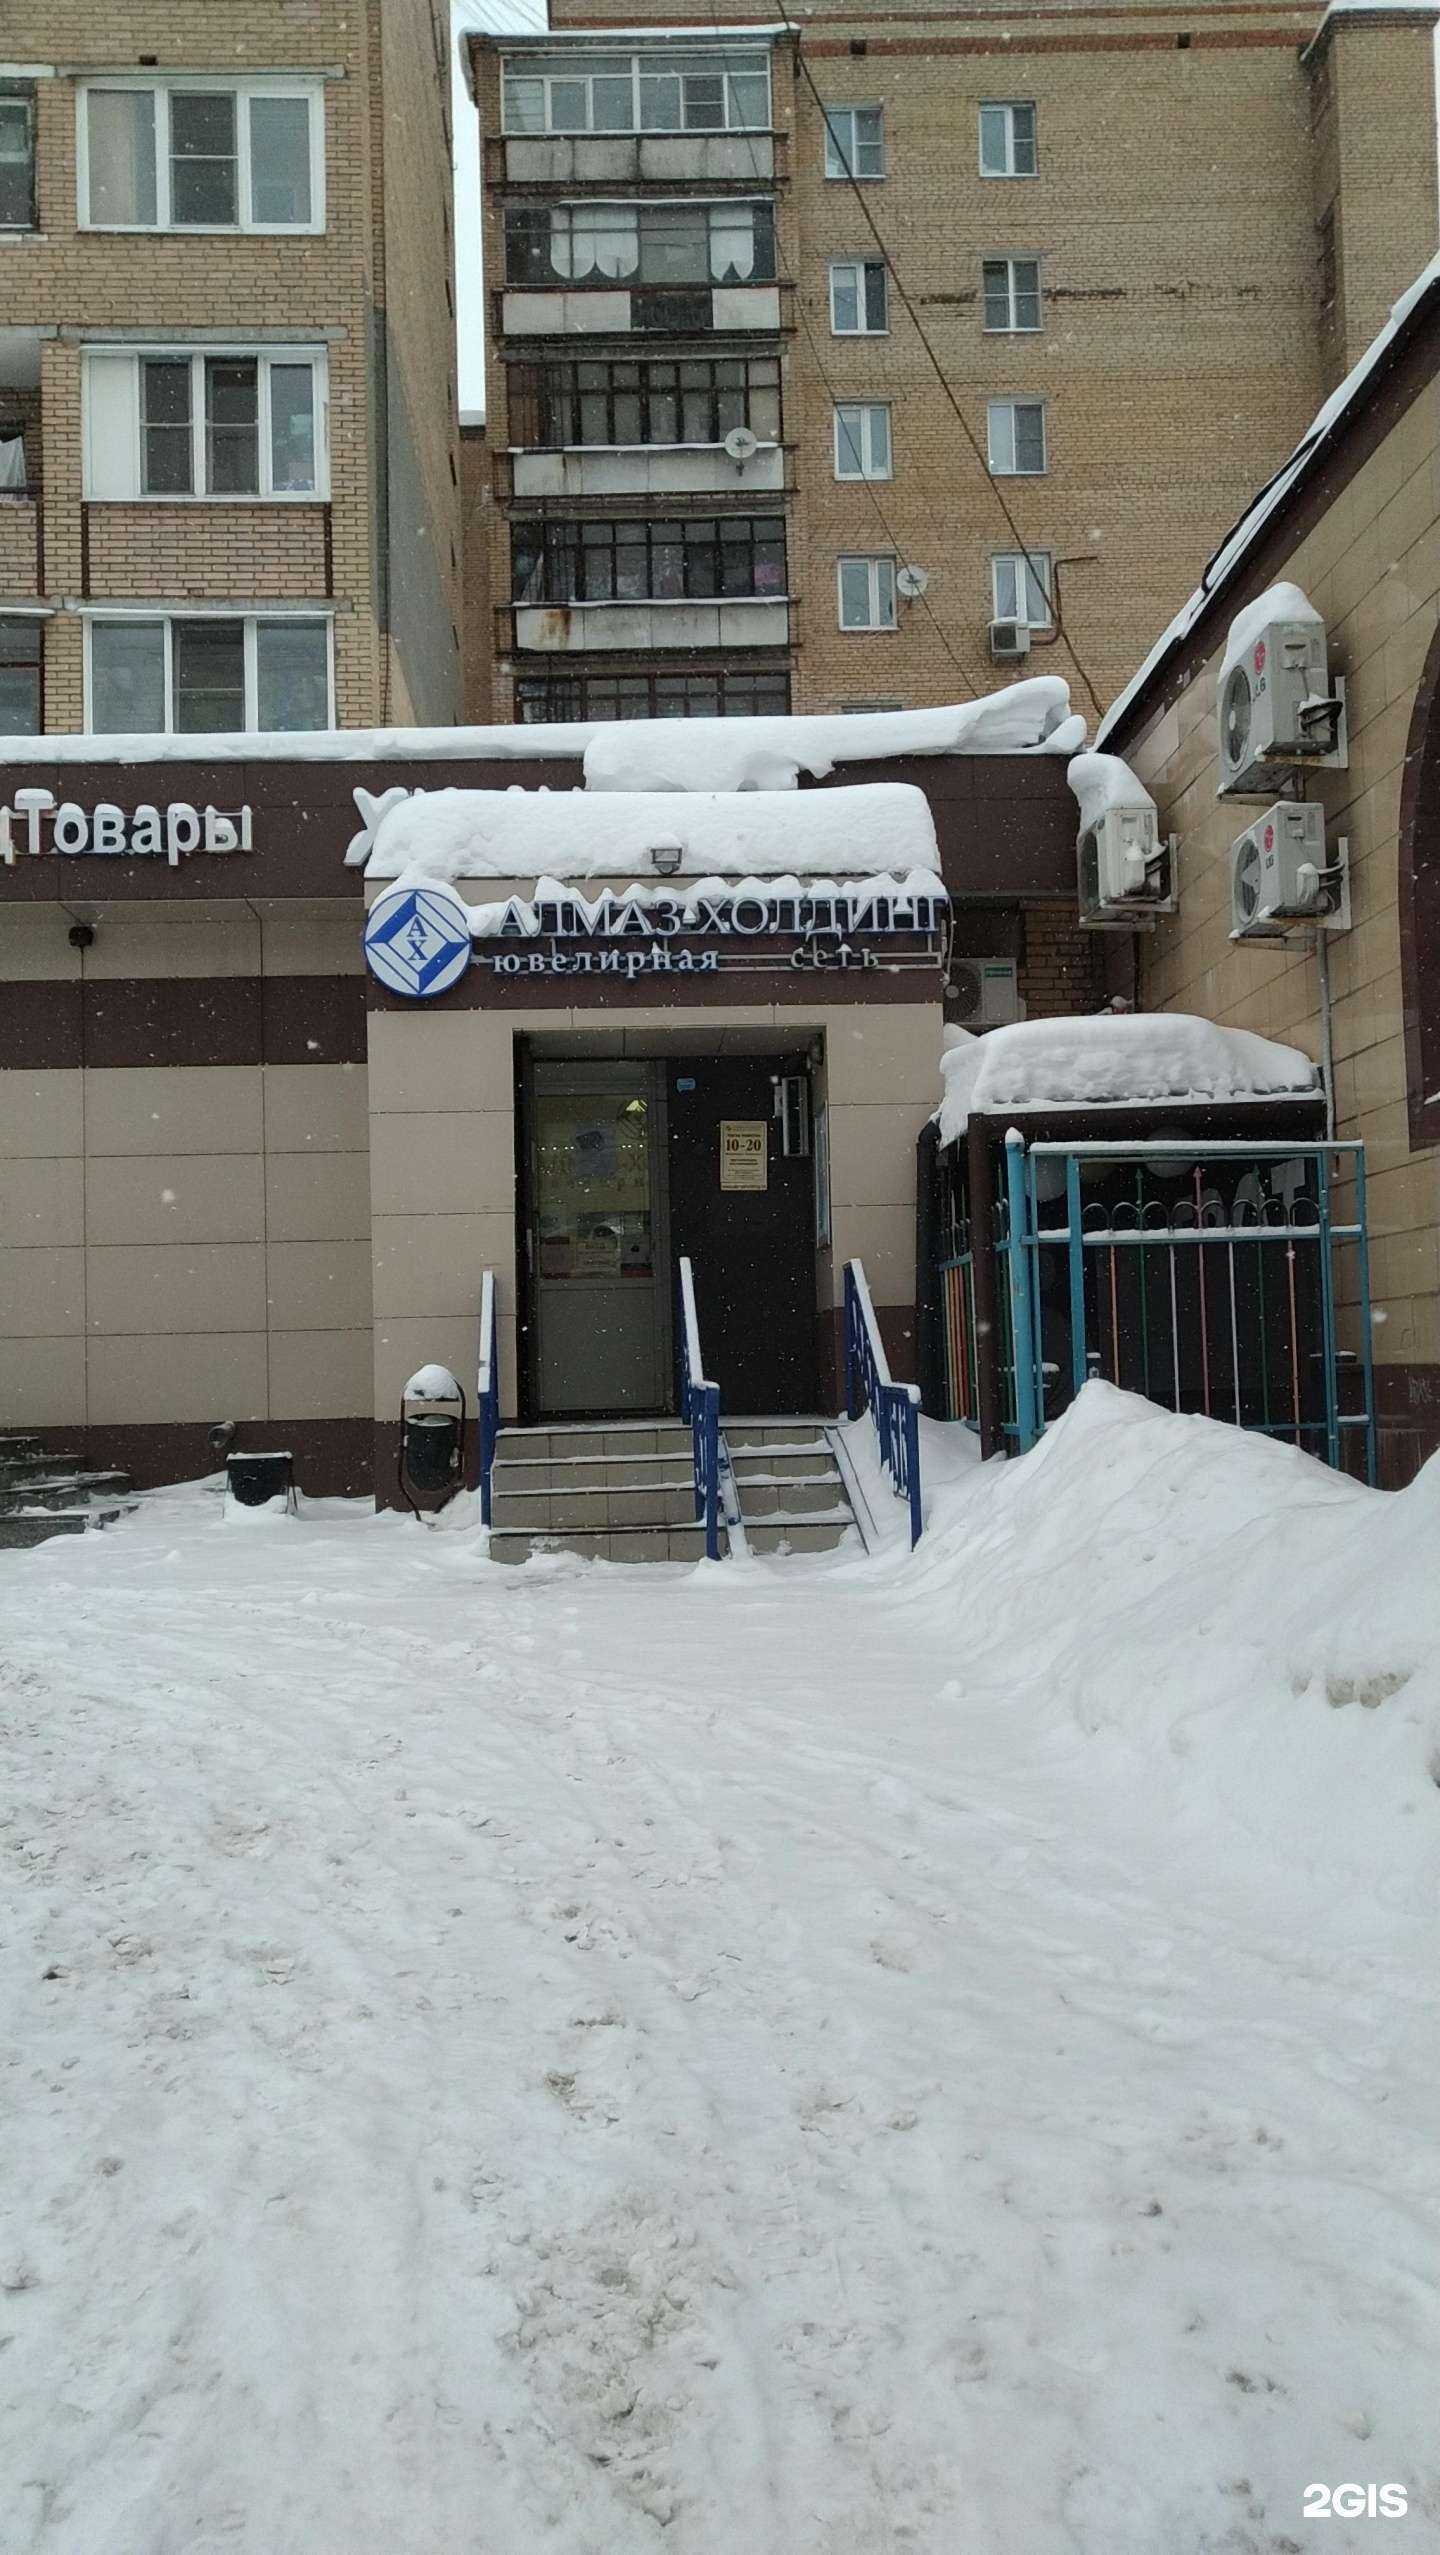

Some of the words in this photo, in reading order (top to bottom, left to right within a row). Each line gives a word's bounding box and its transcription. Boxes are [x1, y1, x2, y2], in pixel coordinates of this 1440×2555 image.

[1252, 677, 1267, 703] LG
[1265, 854, 1275, 870] LG
[493, 949, 720, 980] ювелирная
[790, 946, 879, 968] сеть
[726, 1139, 762, 1152] 10-20
